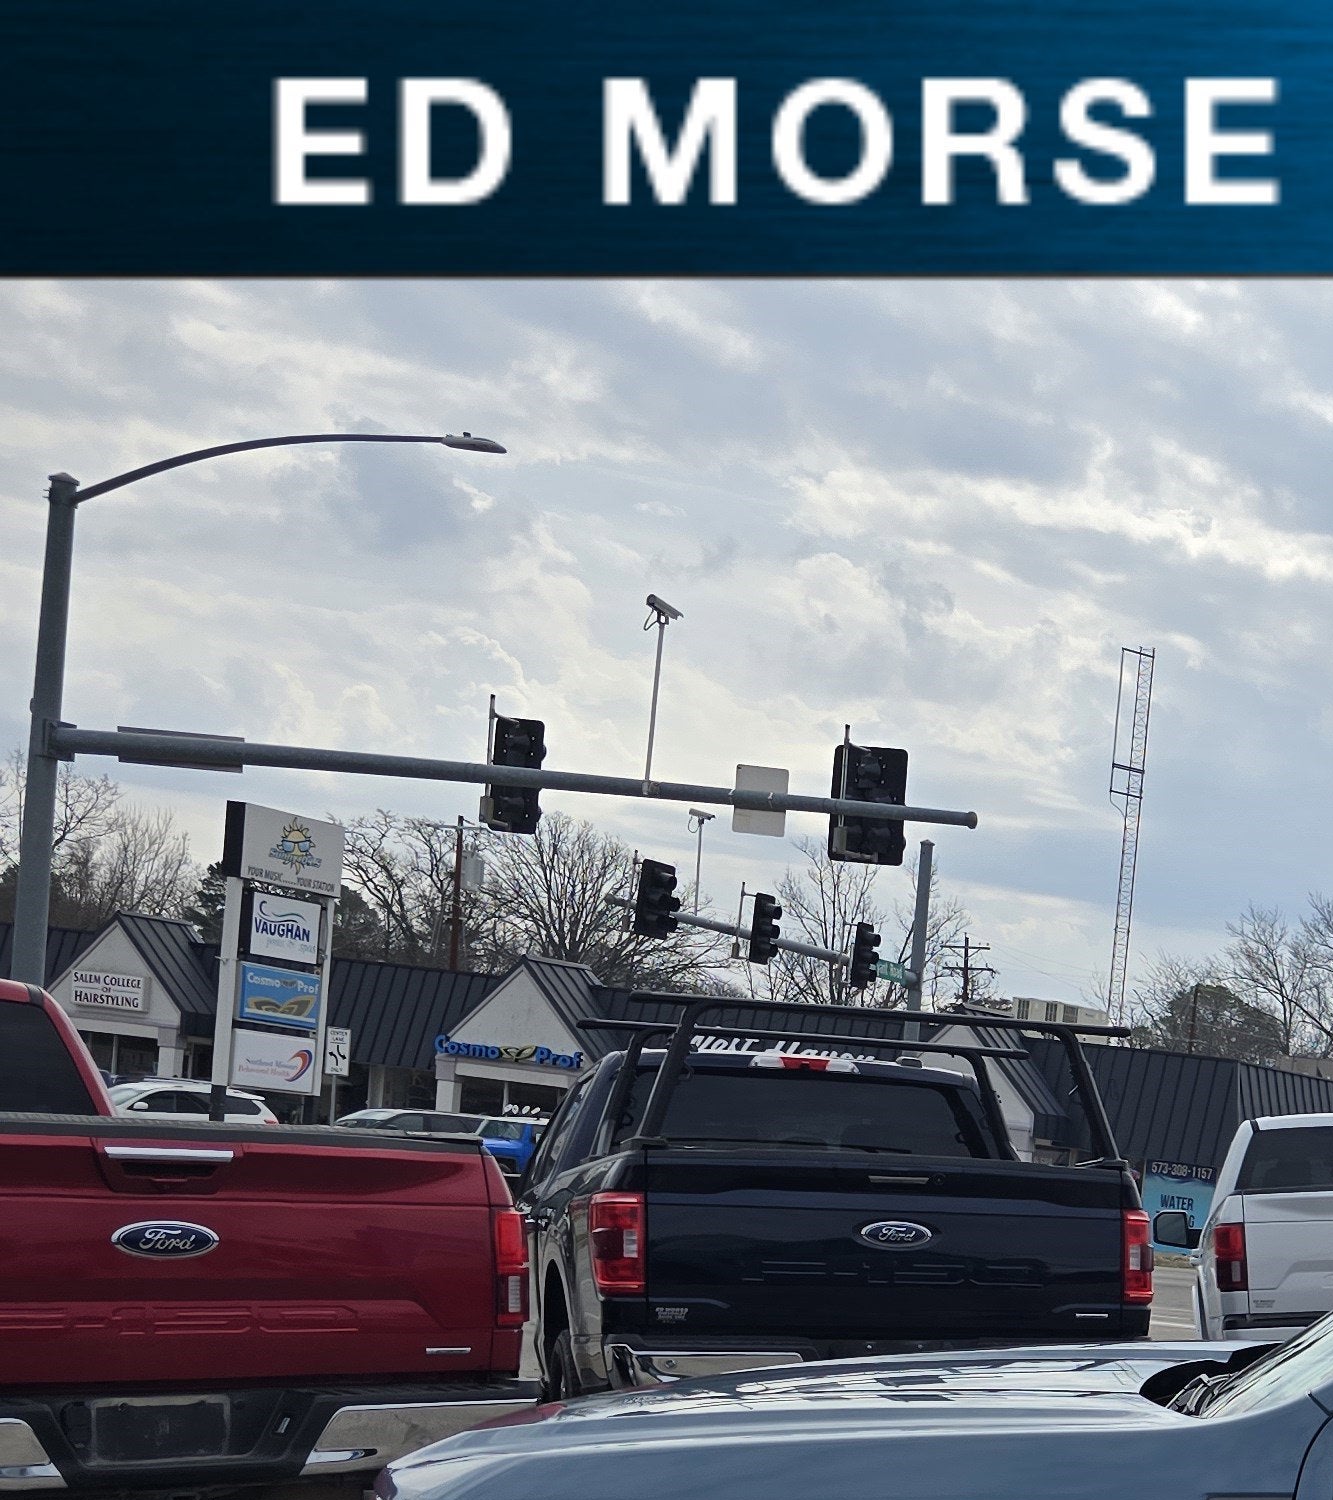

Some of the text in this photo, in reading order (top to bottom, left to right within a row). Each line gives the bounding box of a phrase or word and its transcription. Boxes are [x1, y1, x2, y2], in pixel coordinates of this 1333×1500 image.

[254, 916, 311, 942] VAUGHAN
[73, 971, 142, 989] SALEM COLLEGE
[247, 972, 320, 995] Cosmo Prof
[74, 990, 139, 1008] HAIRSTYLING
[434, 1034, 584, 1069] Cosmo Prof
[1151, 1161, 1213, 1180] 573-308-1157
[1160, 1193, 1194, 1211] WATER
[139, 1227, 196, 1251] Ford
[877, 1225, 916, 1243] Ford
